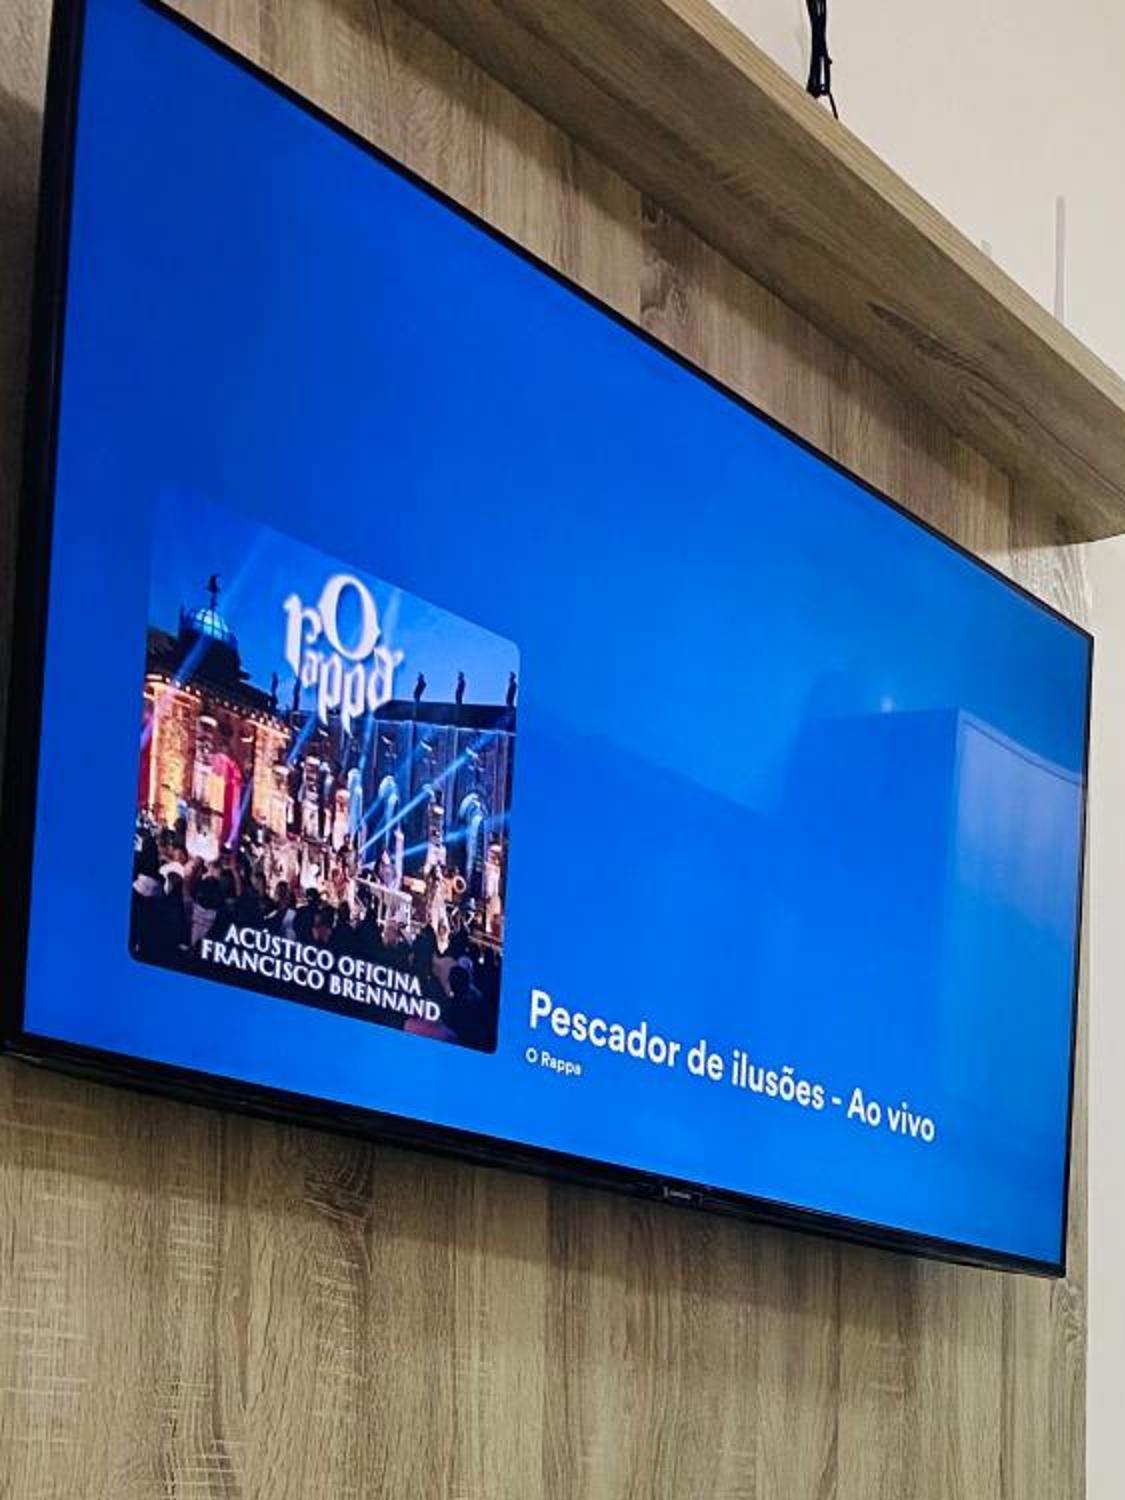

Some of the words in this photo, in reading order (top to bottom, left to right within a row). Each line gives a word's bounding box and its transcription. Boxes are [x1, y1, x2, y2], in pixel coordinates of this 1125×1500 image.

[200, 938, 324, 990] FRANCISCO
[328, 974, 441, 1022] BRENNAND
[225, 922, 333, 971] ACÚSTICO
[337, 955, 422, 996] OFICINA
[525, 1047, 538, 1065] O
[541, 1050, 582, 1077] Rappa
[529, 989, 681, 1068] Pescador
[687, 1040, 724, 1081] de
[731, 1050, 825, 1111] ilusões
[847, 1088, 882, 1127] Ao
[888, 1102, 937, 1144] vivo
